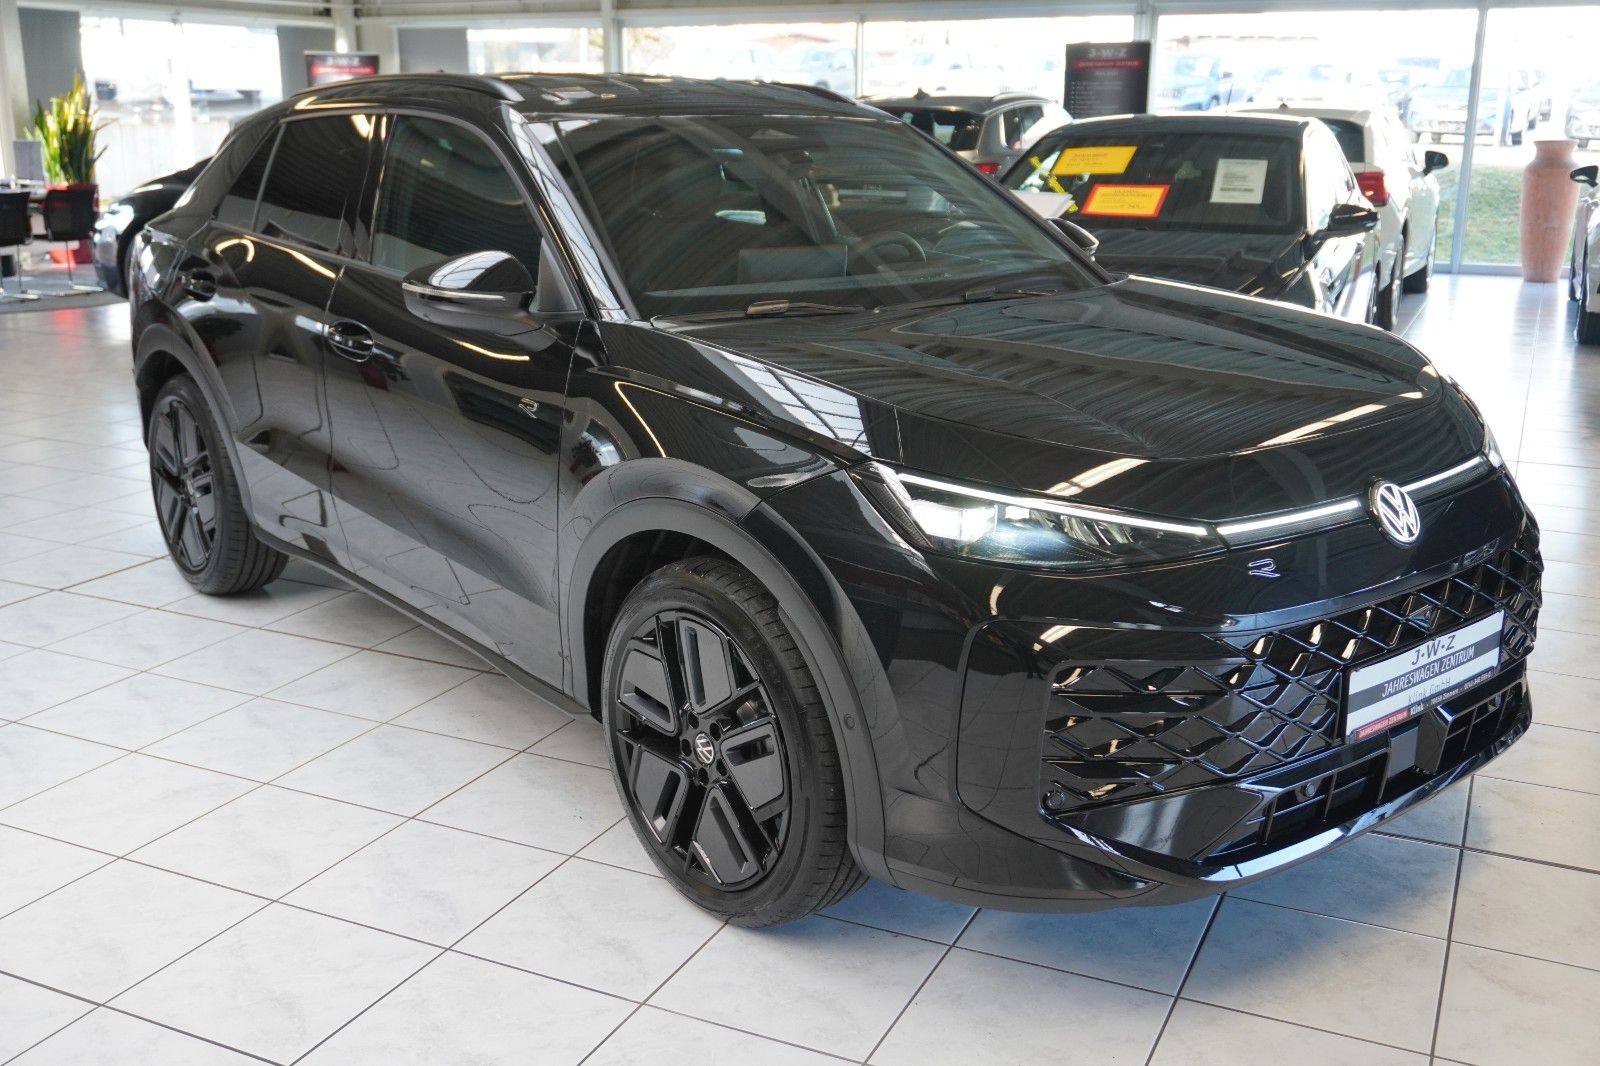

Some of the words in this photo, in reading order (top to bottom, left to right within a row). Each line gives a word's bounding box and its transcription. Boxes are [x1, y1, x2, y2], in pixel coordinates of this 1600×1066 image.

[1377, 483, 1420, 543] VW
[1381, 665, 1439, 698] JAHRESWAGEN
[1440, 646, 1475, 672] ZENTRUM
